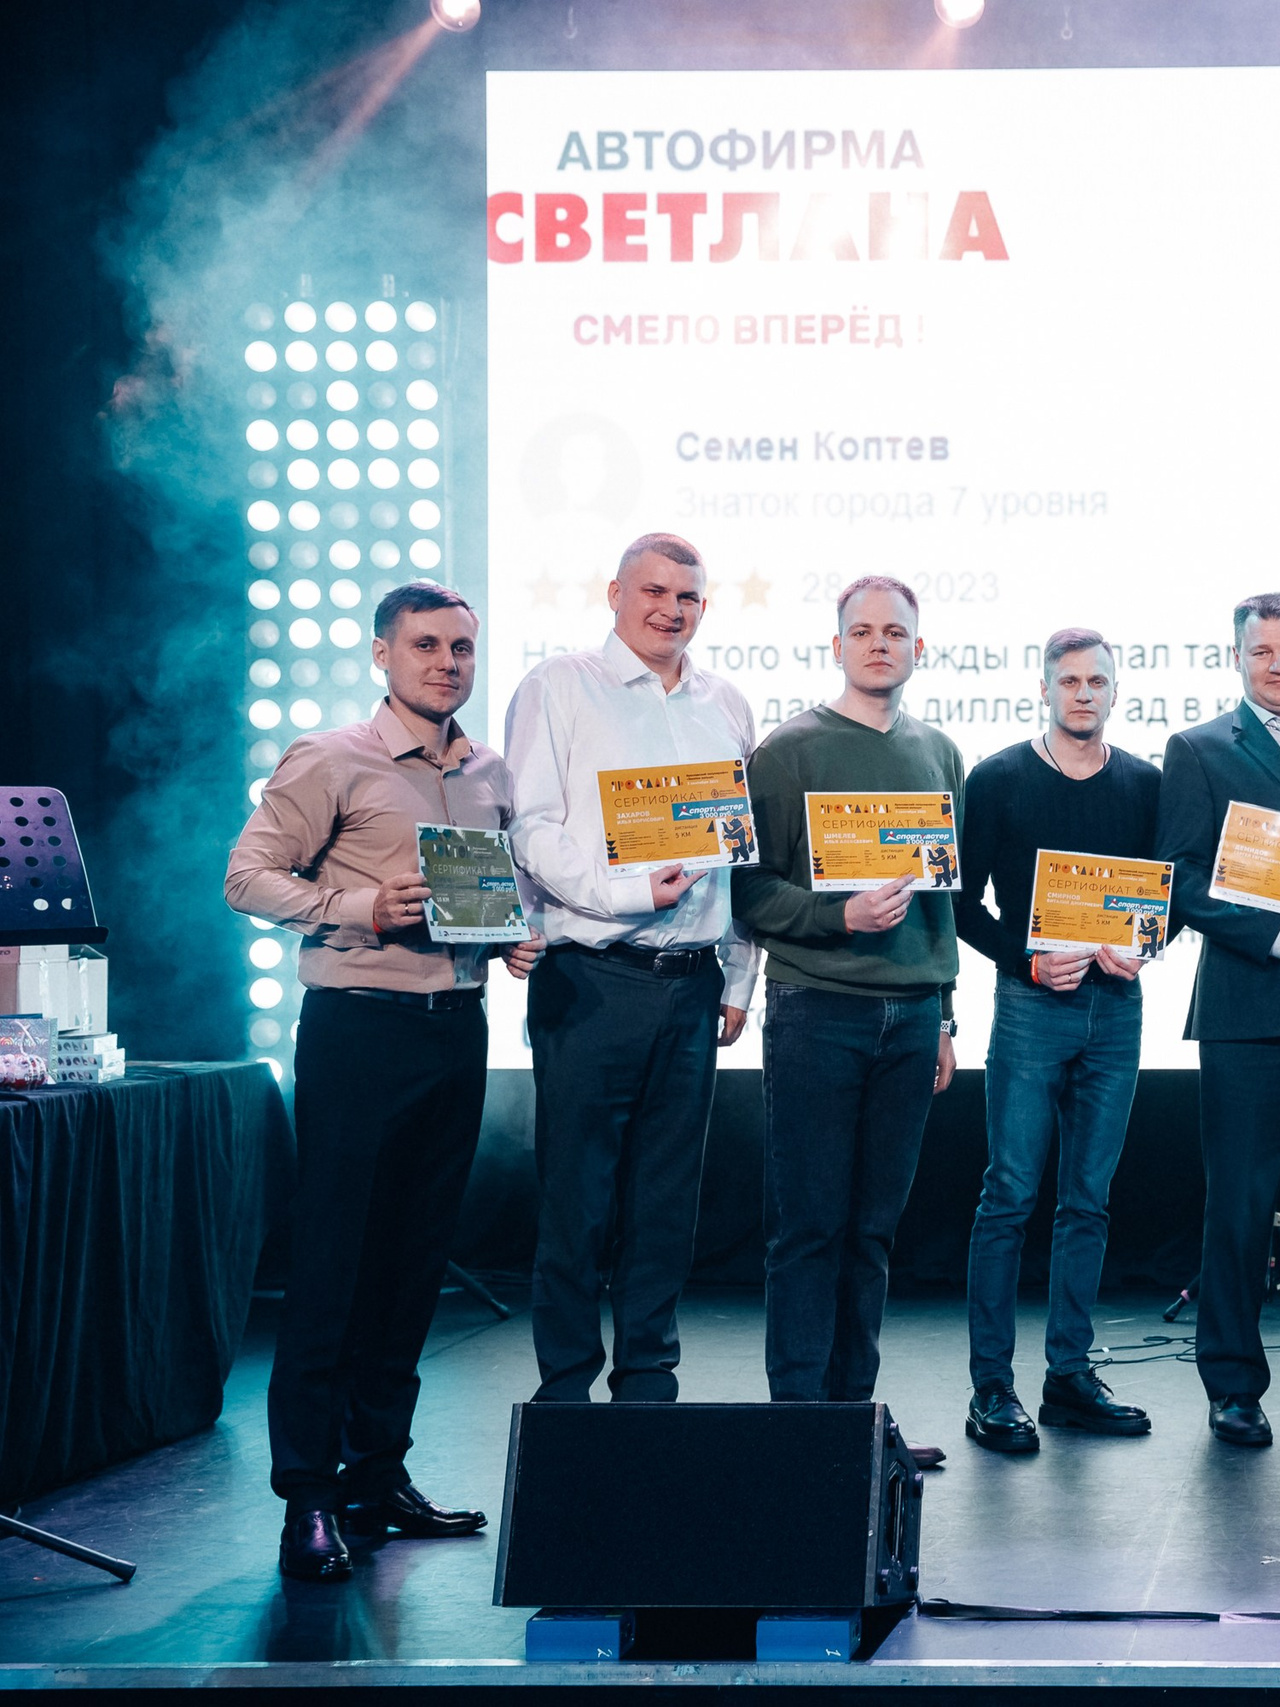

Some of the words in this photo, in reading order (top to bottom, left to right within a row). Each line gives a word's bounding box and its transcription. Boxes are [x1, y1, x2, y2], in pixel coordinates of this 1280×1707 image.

[556, 129, 926, 172] АВТОФИРМА
[486, 190, 1011, 264] СВЕТЛАНА
[573, 313, 721, 347] СМЕЛО
[733, 305, 904, 349] ВПЕРЁД
[675, 431, 799, 463] Семен
[813, 431, 951, 462] Коптев
[675, 488, 799, 518] Знаток
[812, 494, 936, 524] города
[948, 487, 968, 517] 7
[980, 493, 1109, 524] уровня
[707, 645, 779, 670] того
[1184, 698, 1202, 722] в
[614, 791, 704, 808] СЕРТИФИКАТ
[616, 810, 650, 820] ЗАХАРОВ
[822, 819, 911, 829] СЕРТИФИКАТ
[823, 832, 857, 840] ШМЕЛЕВ
[432, 864, 487, 875] СЕРТИФИКАТ
[1047, 891, 1081, 901] СМИРНОВ
[1048, 878, 1131, 895] СЕРТИФИКАТ
